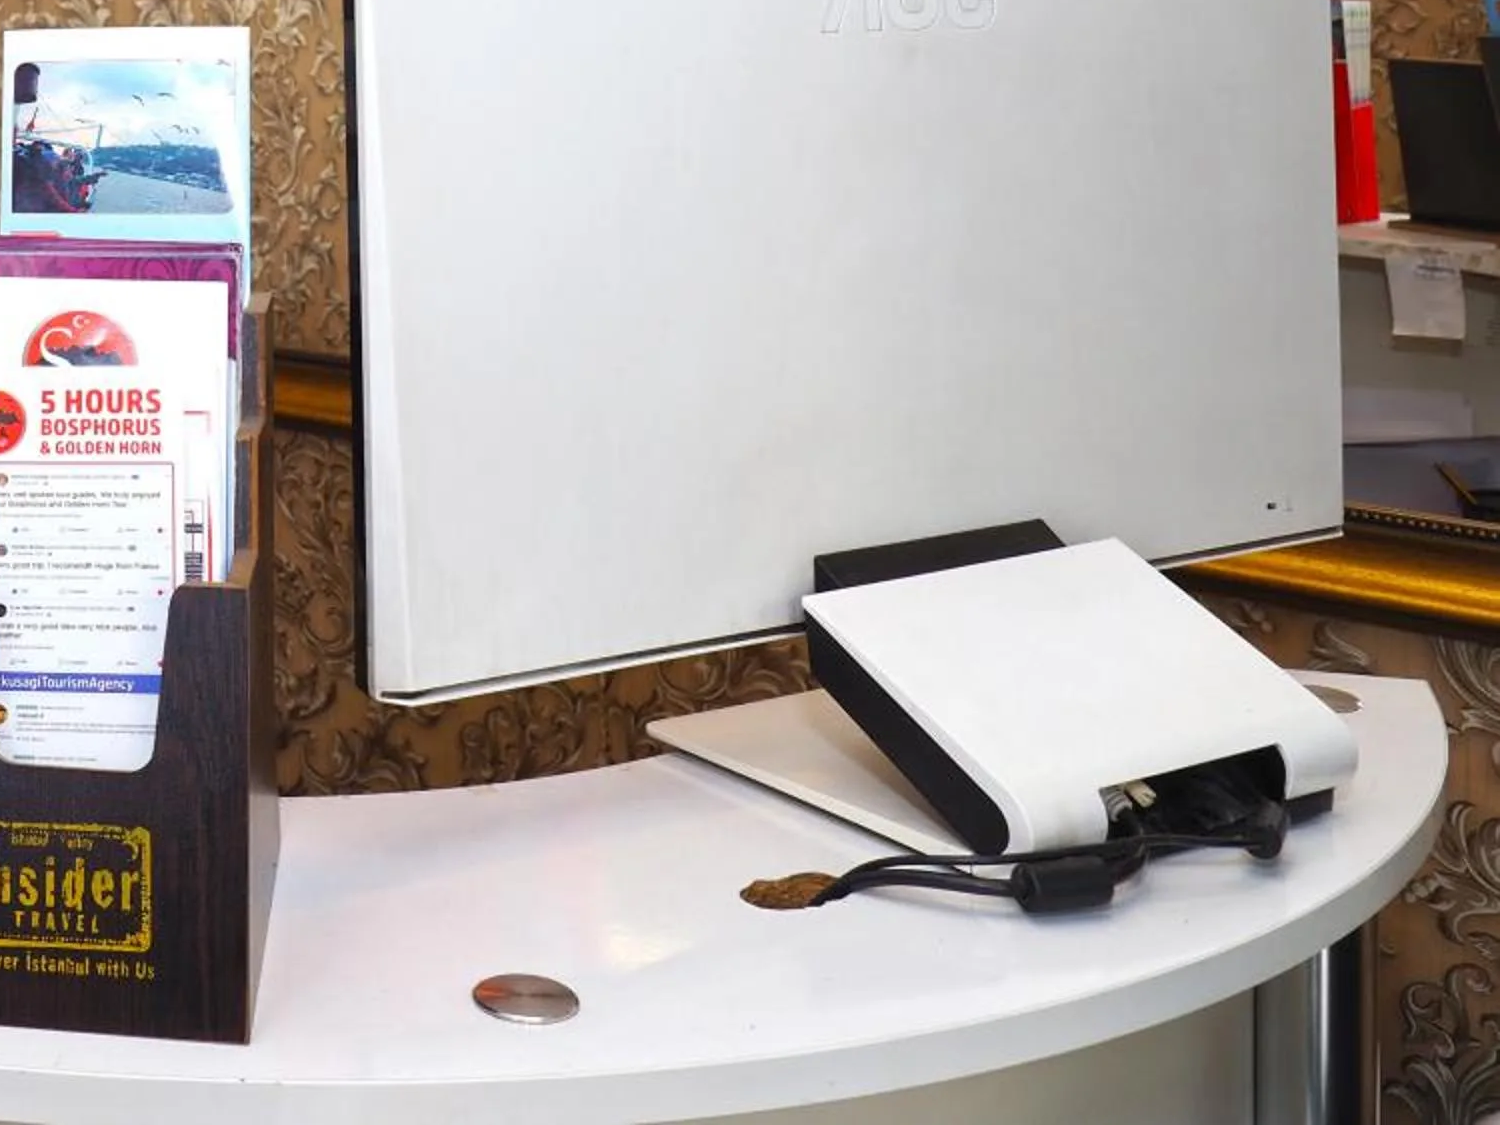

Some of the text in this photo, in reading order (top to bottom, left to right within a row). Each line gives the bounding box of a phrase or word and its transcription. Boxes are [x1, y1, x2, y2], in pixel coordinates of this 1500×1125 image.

[40, 388, 162, 415] 5 HOURS
[40, 418, 162, 437] BOSPHORUS
[40, 440, 162, 455] & GOLDEN HORN
[13, 910, 101, 934] TRAVEL
[95, 959, 129, 979] with
[135, 961, 156, 980] Us
